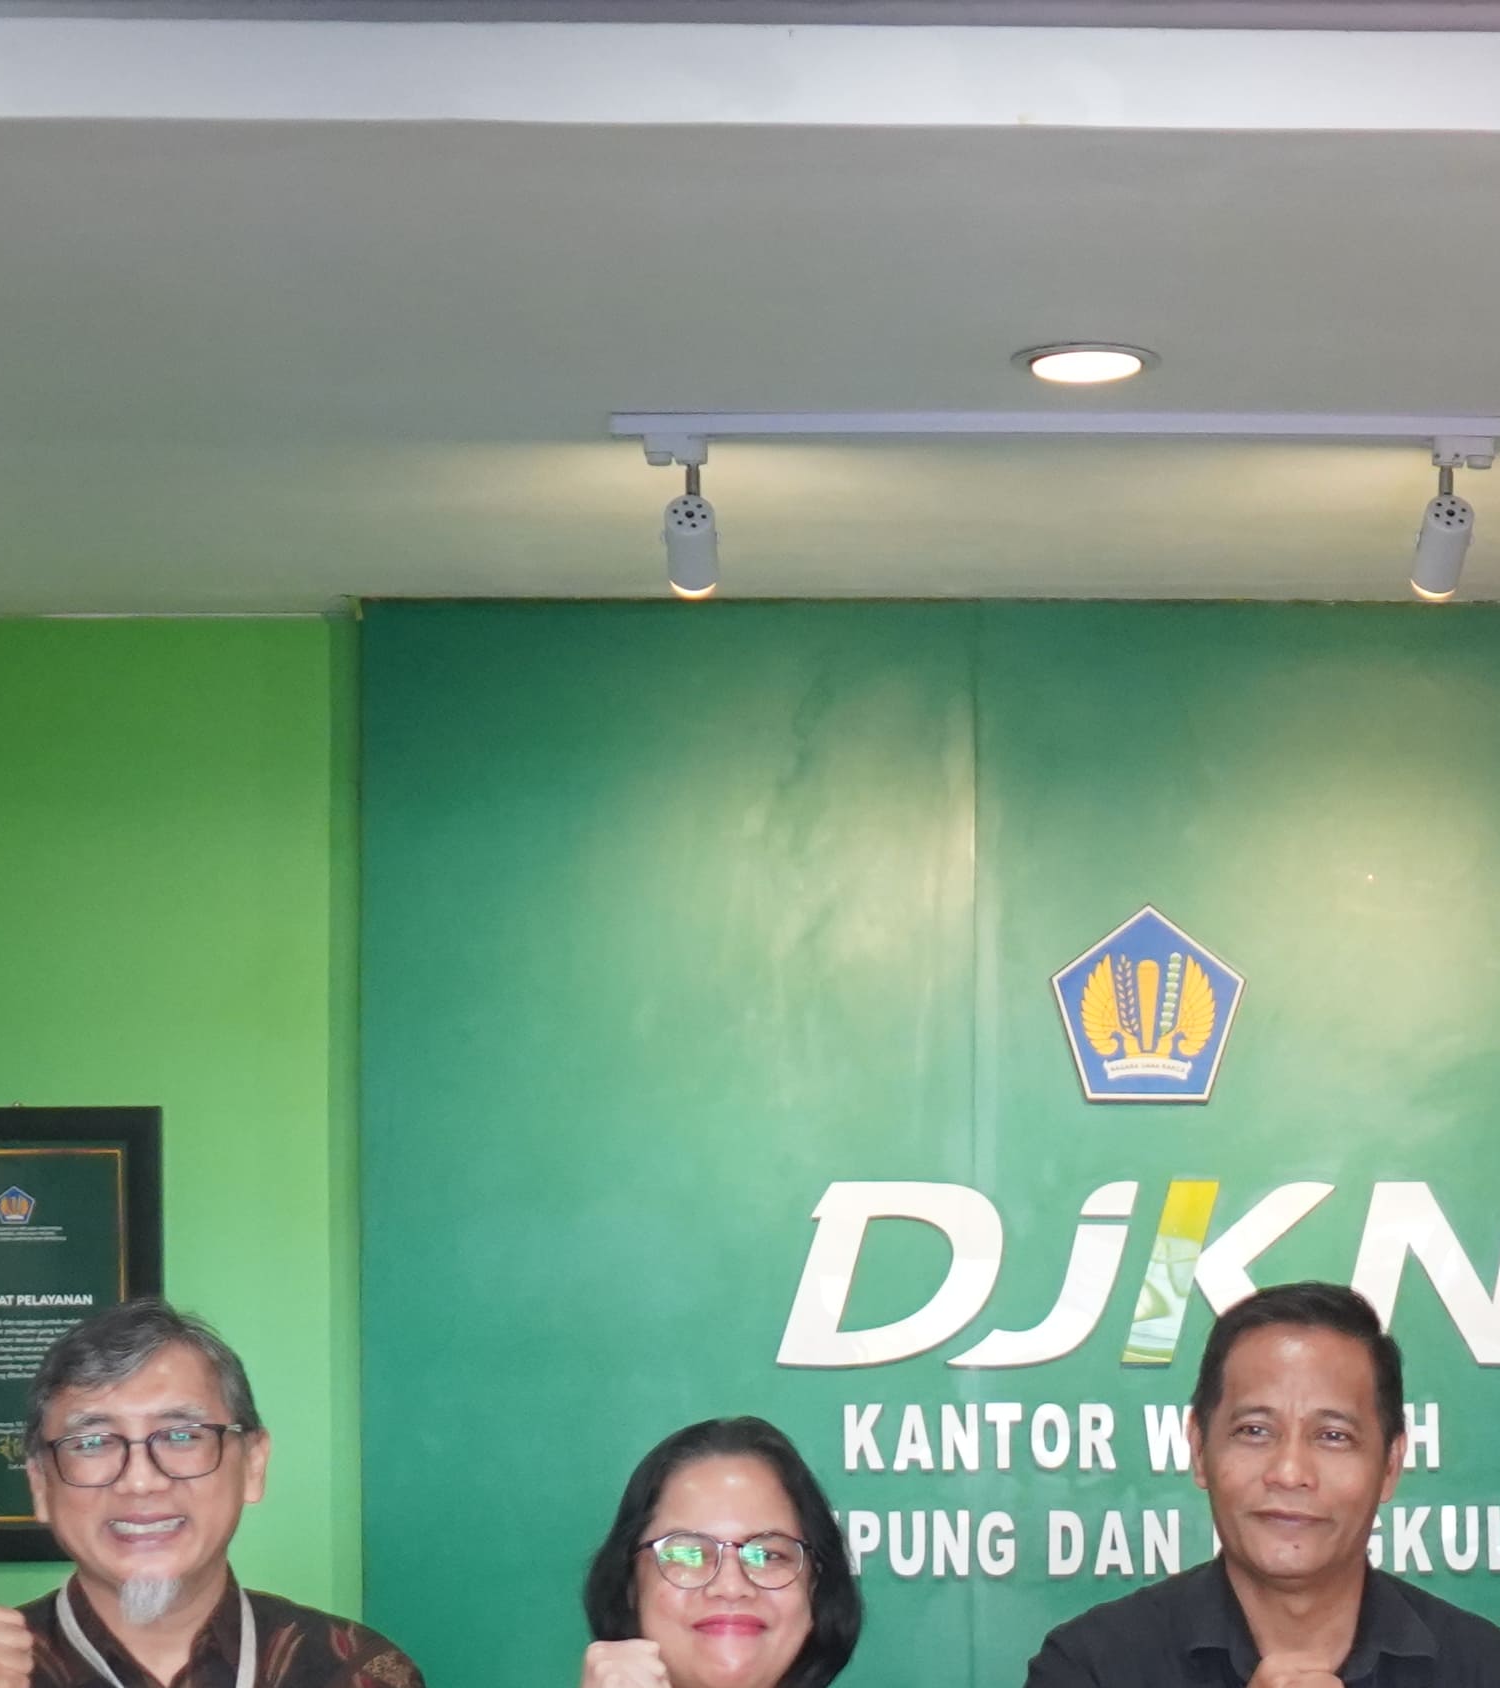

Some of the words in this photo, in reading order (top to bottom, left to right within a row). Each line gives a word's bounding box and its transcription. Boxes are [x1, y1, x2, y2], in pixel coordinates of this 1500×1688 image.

[16, 1294, 93, 1305] PELAYANAN
[843, 1402, 1117, 1471] KANTOR
[1047, 1509, 1181, 1577] DAN
